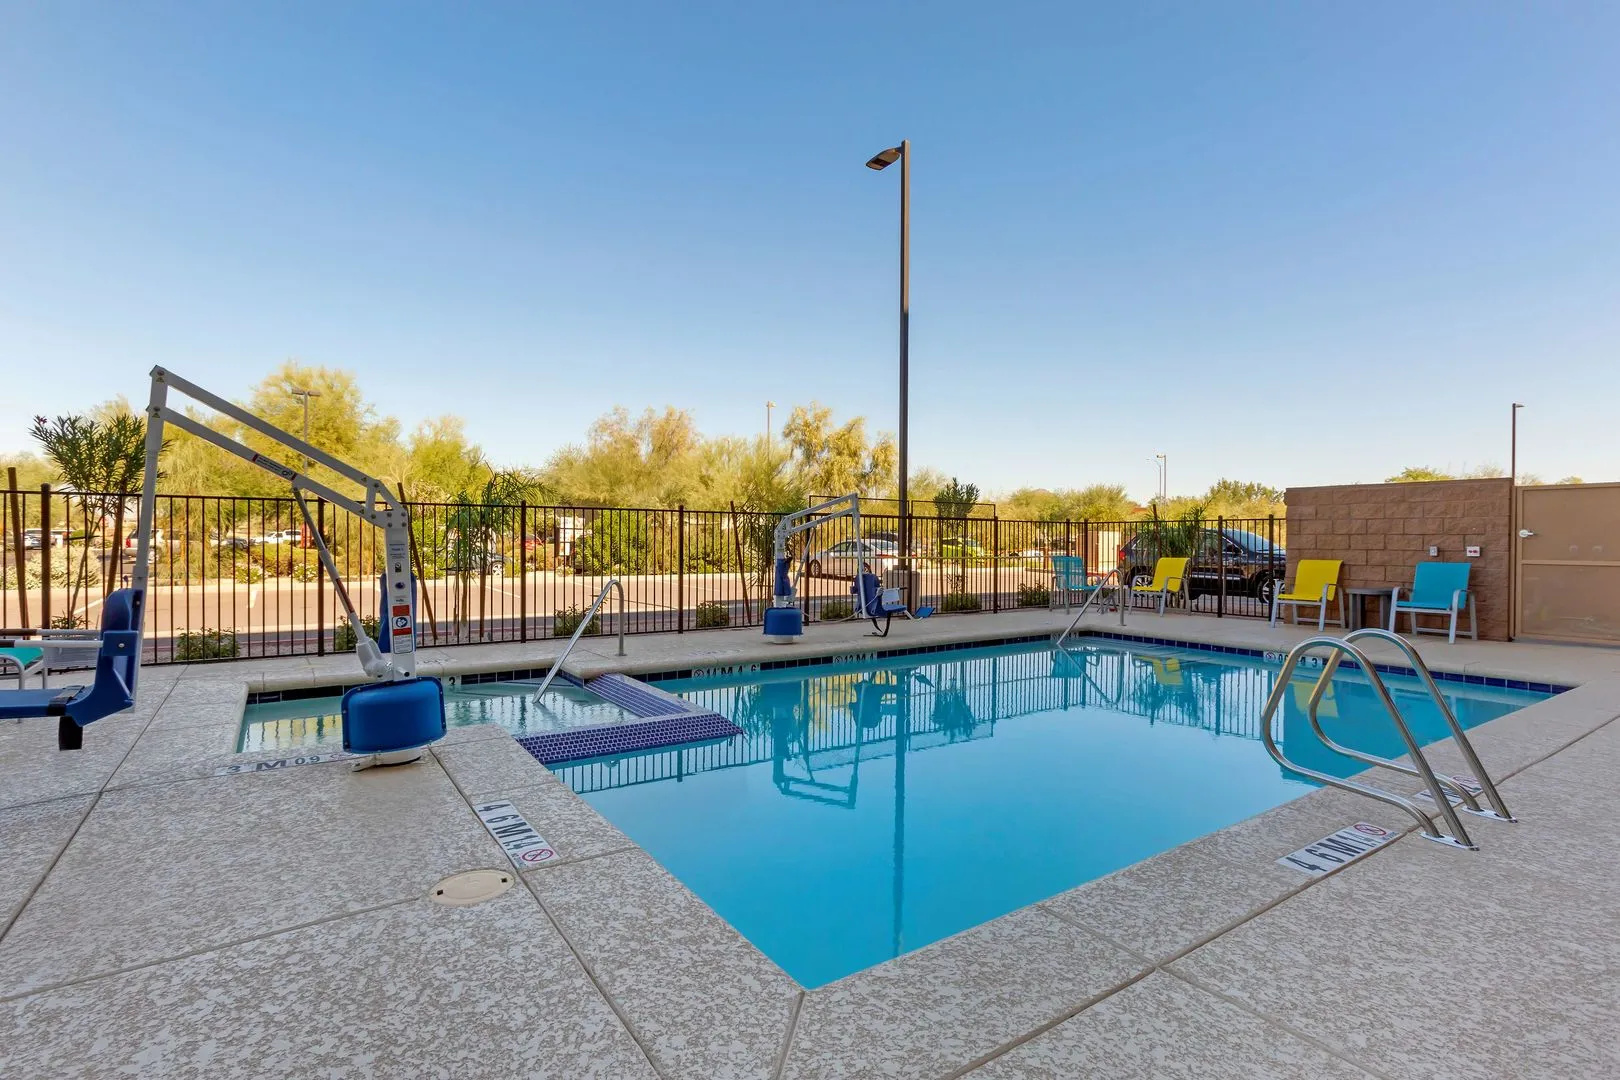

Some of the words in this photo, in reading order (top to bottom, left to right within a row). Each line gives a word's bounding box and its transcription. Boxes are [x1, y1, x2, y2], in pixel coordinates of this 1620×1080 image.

[255, 759, 287, 771] M
[492, 821, 533, 839] M
[1285, 856, 1328, 872] 4
[1316, 837, 1366, 857] M
